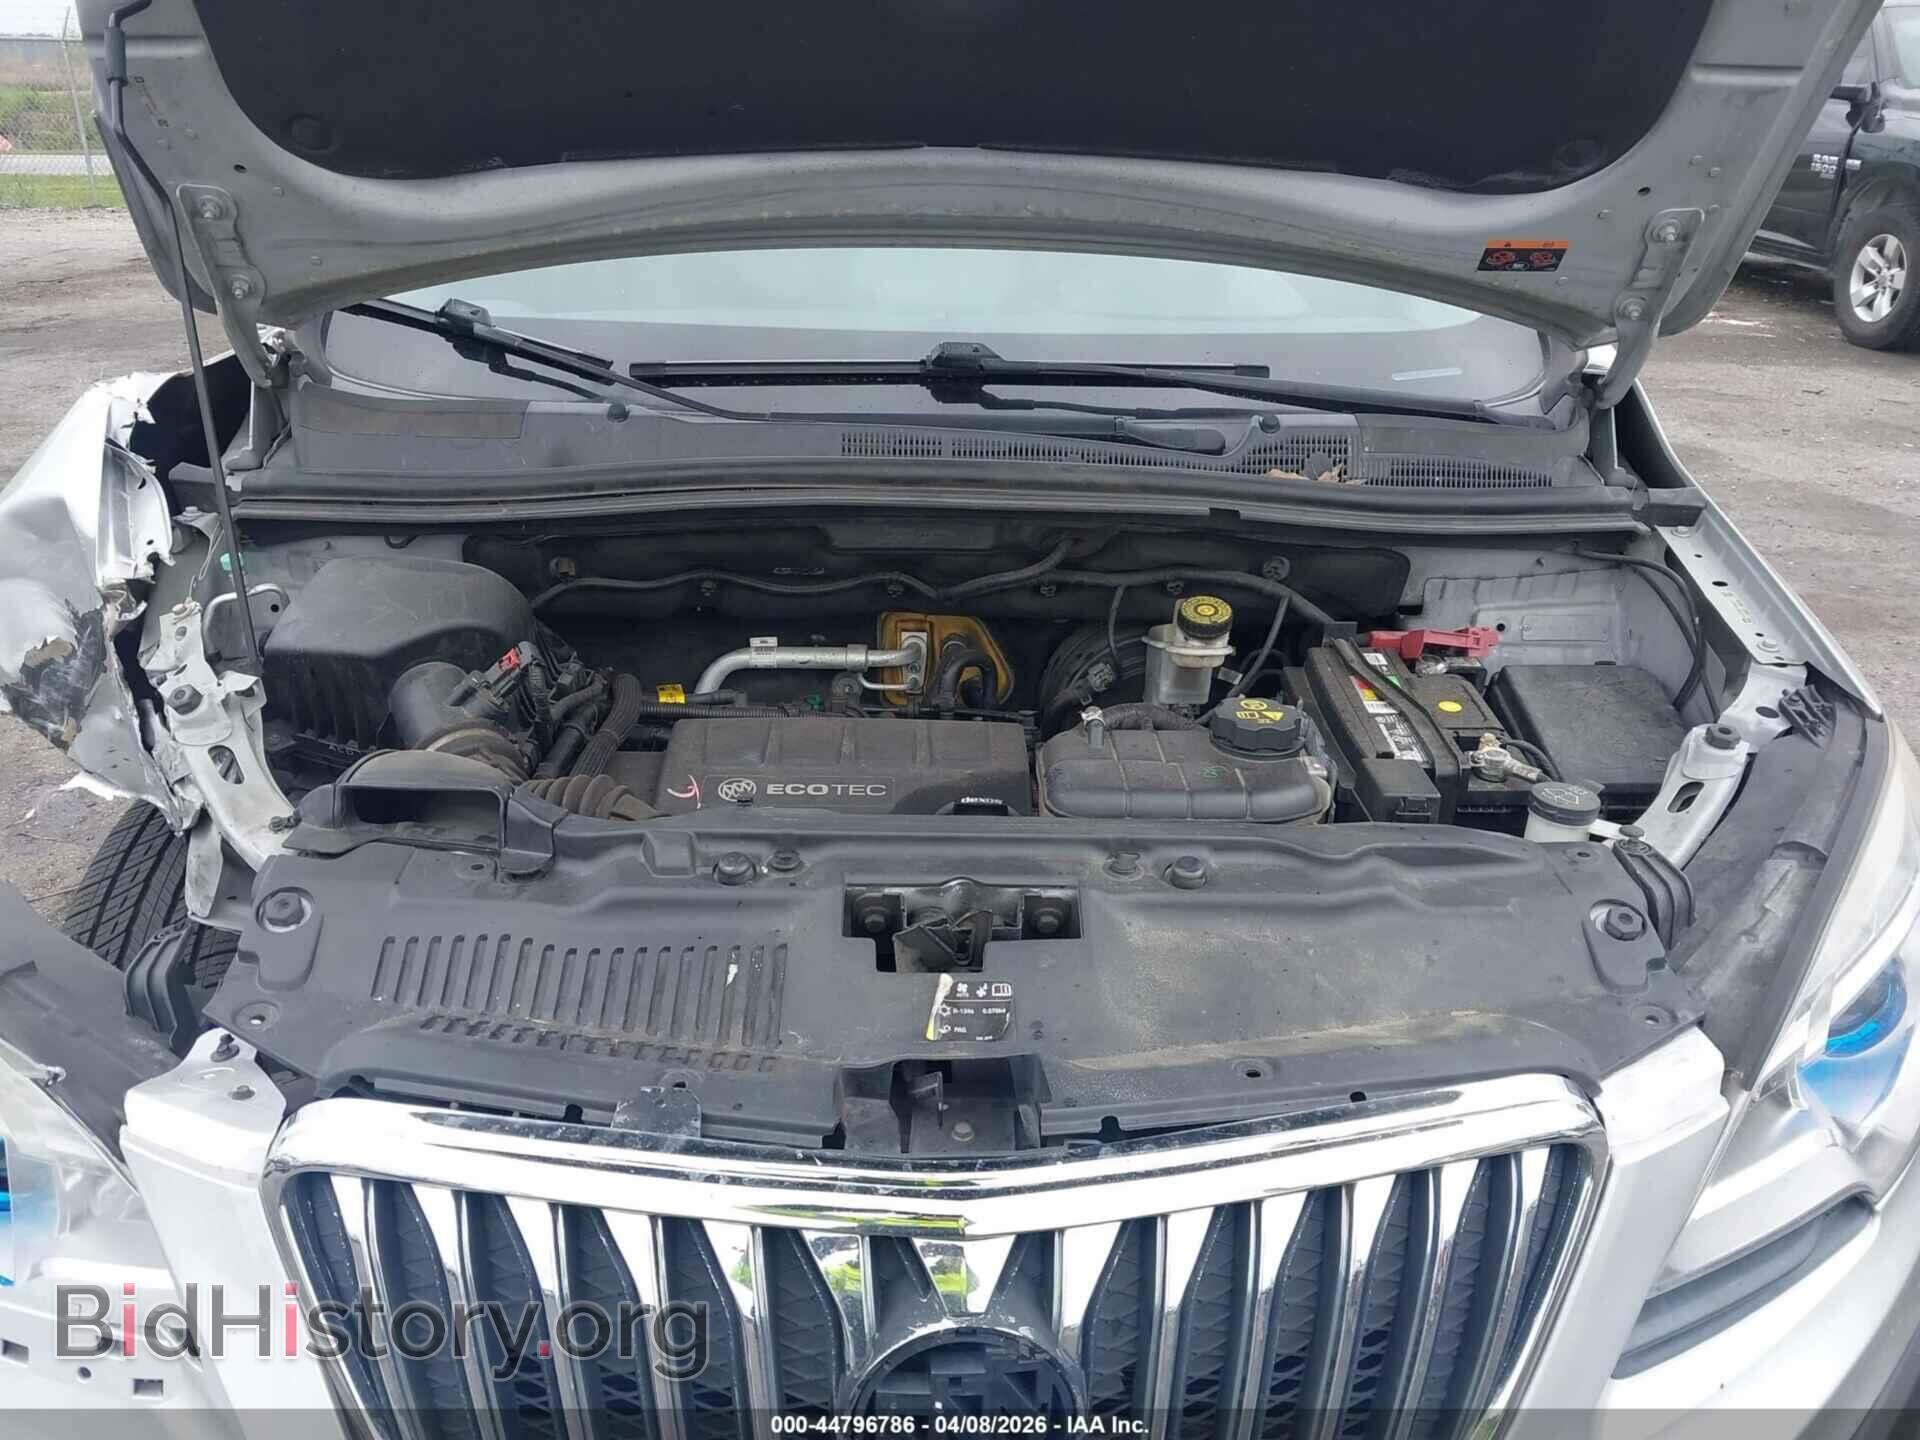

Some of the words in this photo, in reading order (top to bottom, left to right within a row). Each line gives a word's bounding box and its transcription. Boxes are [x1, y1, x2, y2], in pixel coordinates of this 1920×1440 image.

[1813, 153, 1839, 165] RAM
[1810, 163, 1837, 174] 1500
[766, 783, 887, 796] ECOTEC
[961, 796, 1003, 805] dexos
